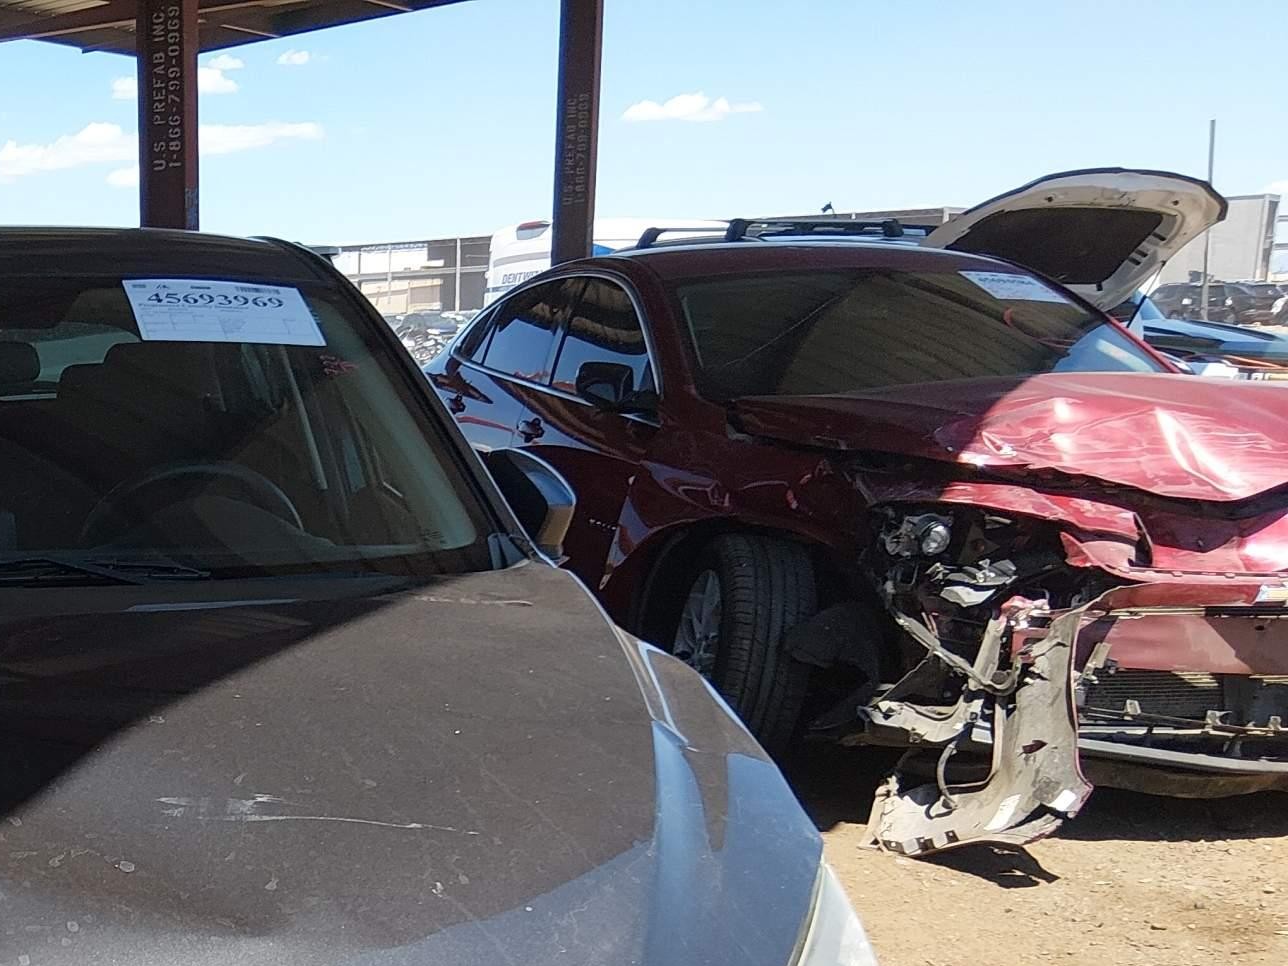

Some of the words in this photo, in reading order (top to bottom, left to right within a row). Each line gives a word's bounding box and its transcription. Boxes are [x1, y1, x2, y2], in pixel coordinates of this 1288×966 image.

[153, 6, 166, 42] INC.
[153, 52, 166, 125] PREFAB
[168, 6, 181, 168] 1-866-799-0969
[147, 292, 284, 308] 45693969
